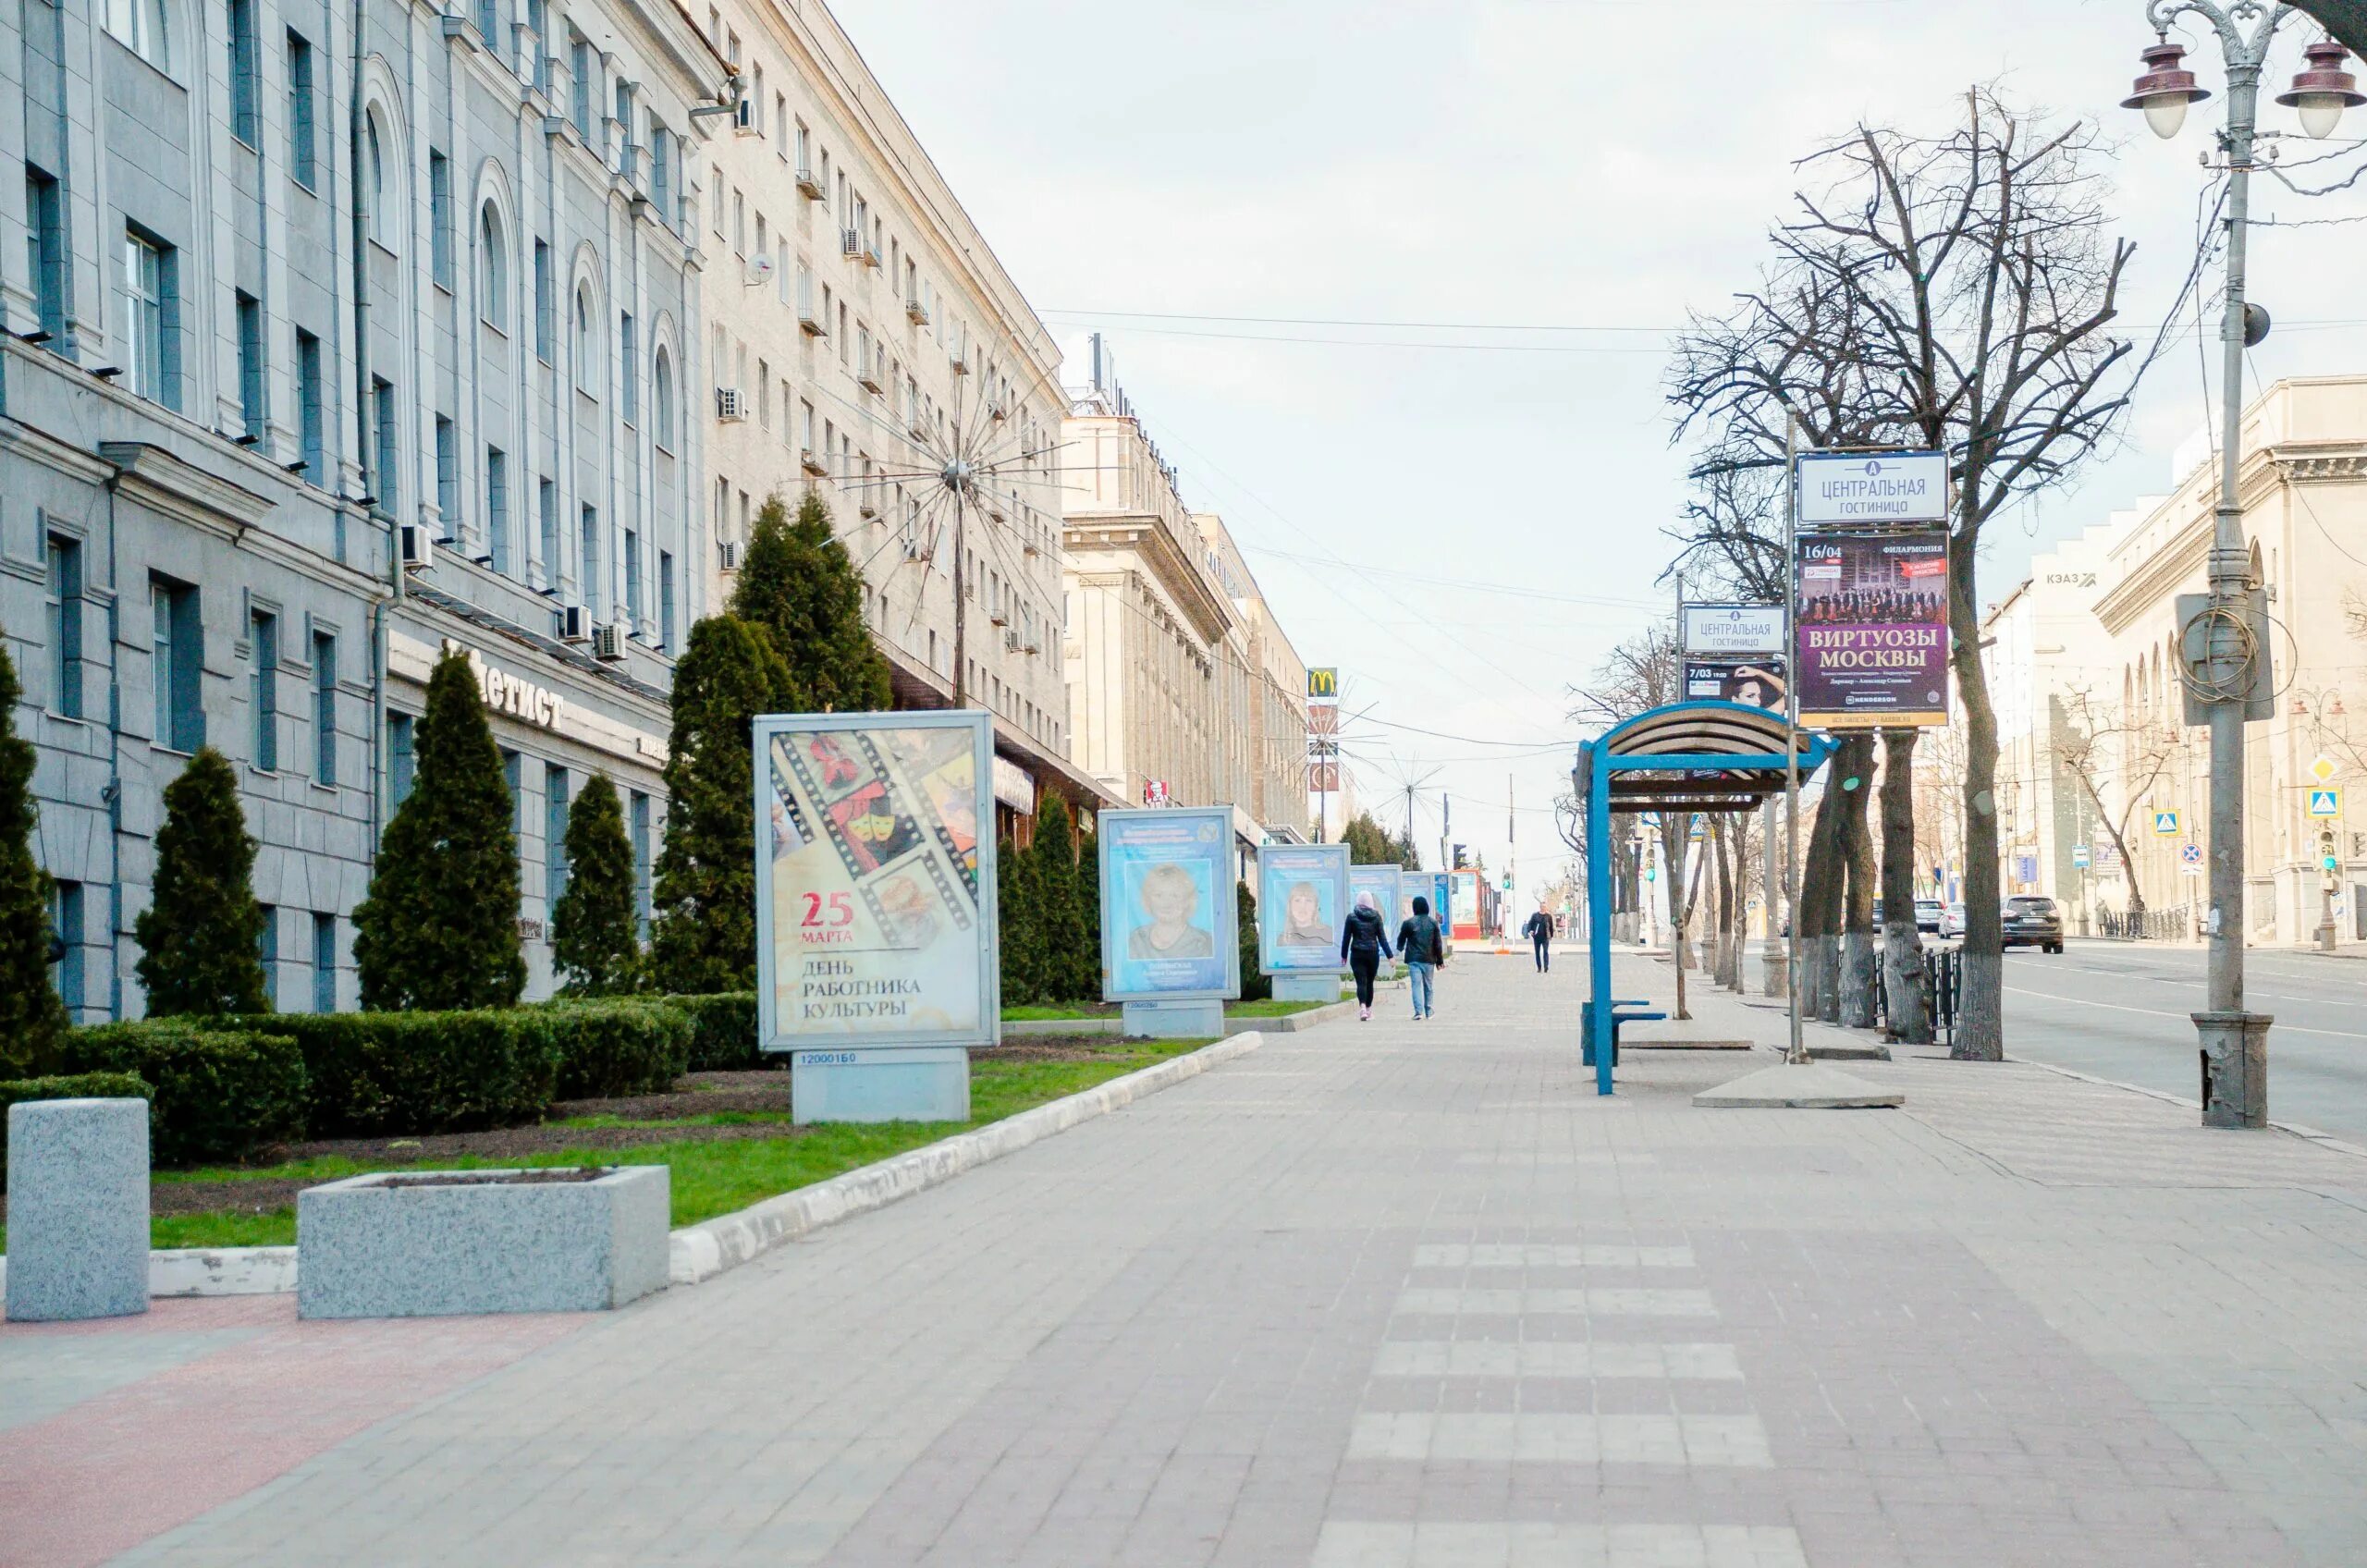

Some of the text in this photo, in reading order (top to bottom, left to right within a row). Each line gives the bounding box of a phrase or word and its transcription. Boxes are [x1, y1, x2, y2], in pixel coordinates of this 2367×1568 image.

[1821, 479, 1926, 500] ЦЕНТРАЛЬНАЯ
[1804, 544, 1842, 559] 16/04
[1883, 545, 1944, 554] ФИЛАРМОНИЯ
[2046, 573, 2079, 584] КЭАЗ
[1700, 623, 1772, 636] ЦЕНТРАЛЬНАЯ
[1809, 629, 1938, 648] ВИРТУОЗЫ
[1819, 649, 1927, 668] МОСКВЫ
[1689, 668, 1711, 680] 7/03
[801, 891, 853, 927] 25
[801, 930, 852, 944] МАРТА
[802, 961, 853, 978] ДЕНЬ
[803, 979, 922, 998] РАБОТНИКА
[803, 1000, 907, 1019] КУЛЬТУРЫ
